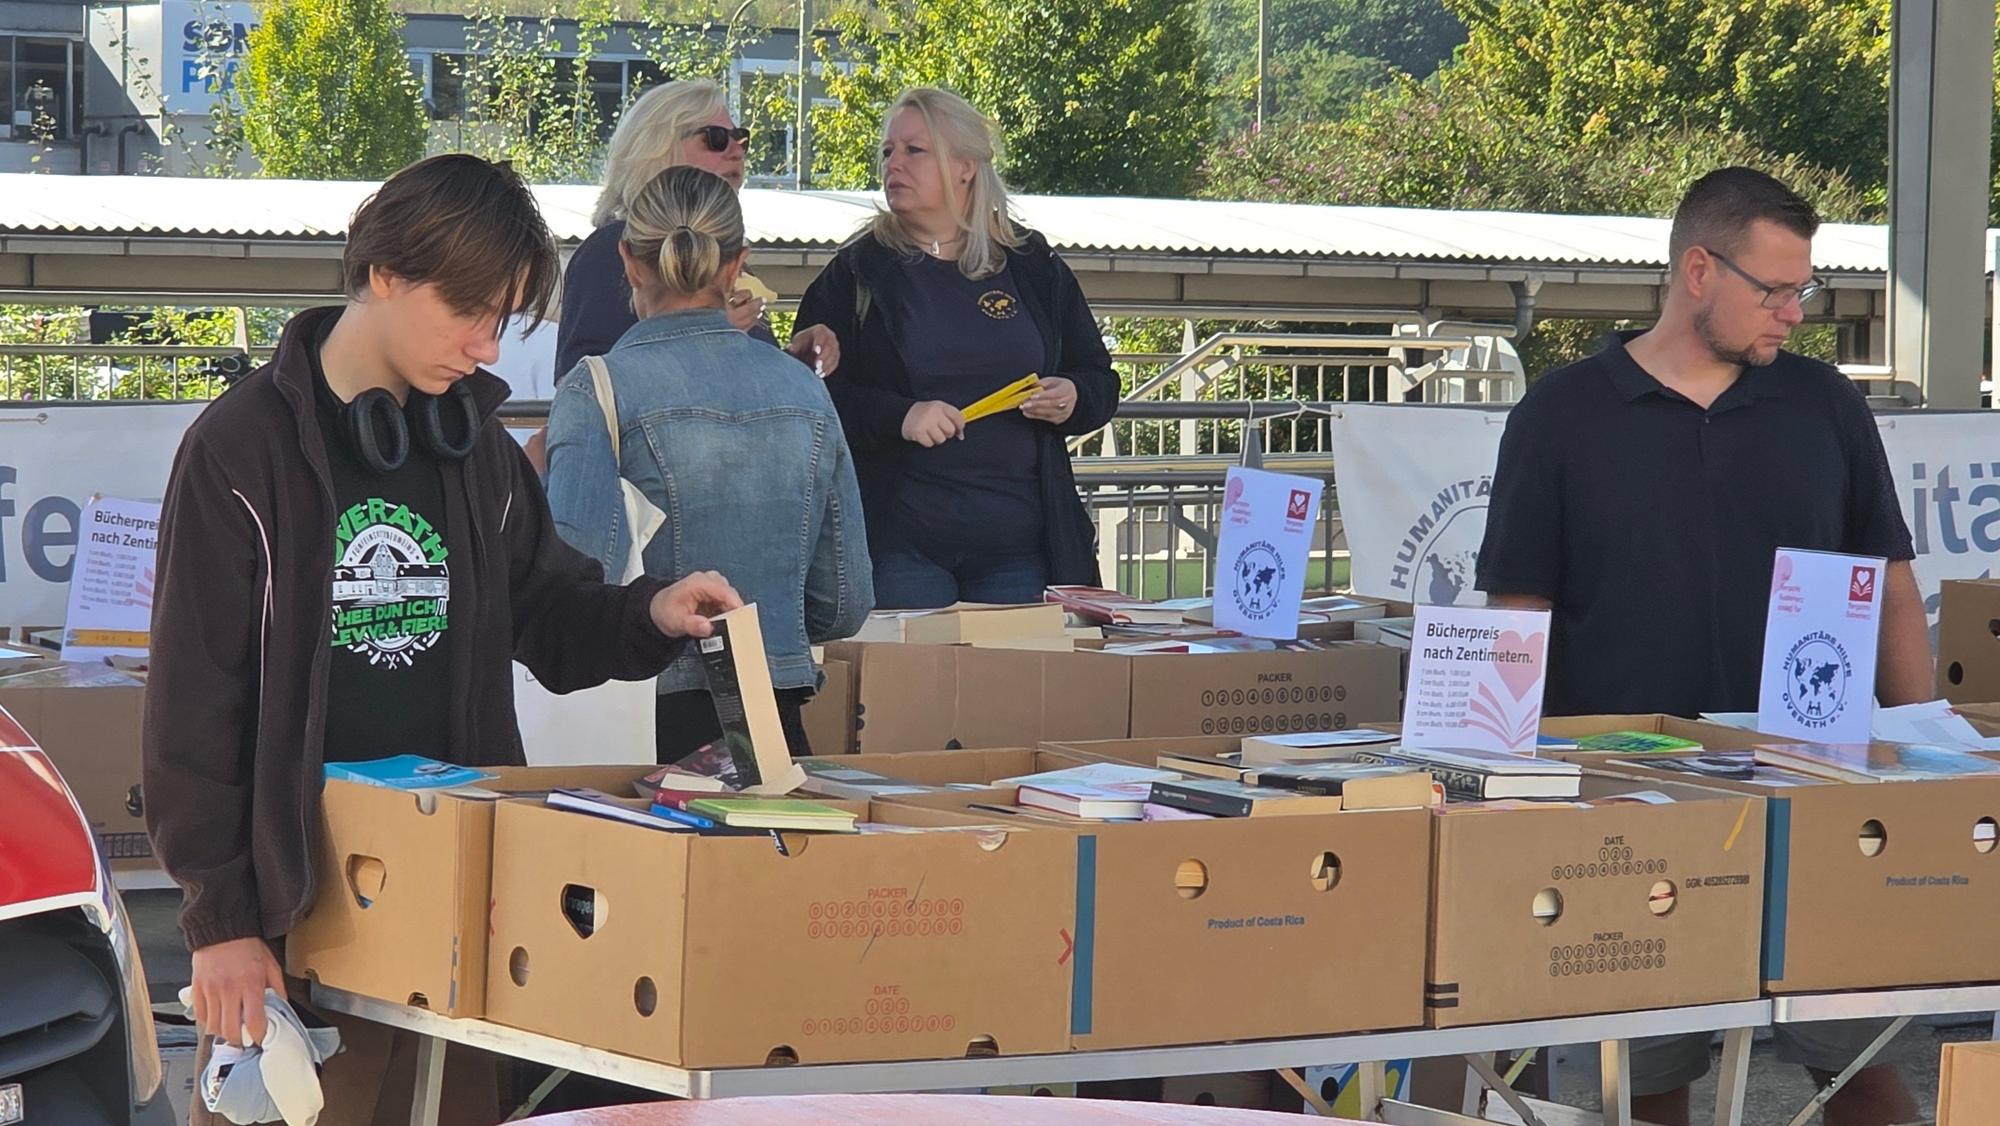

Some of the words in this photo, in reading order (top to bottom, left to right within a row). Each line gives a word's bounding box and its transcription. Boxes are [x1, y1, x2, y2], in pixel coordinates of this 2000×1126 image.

[91, 532, 120, 545] nach
[338, 608, 373, 627] HEE
[407, 600, 437, 616] ICH
[1427, 623, 1500, 642] Bücherpreis
[1424, 646, 1453, 660] nach
[1456, 647, 1533, 664] Zentimetern.
[1837, 643, 1852, 677] HILFE
[1258, 673, 1292, 683] PACKER
[1604, 836, 1625, 846] DATE
[868, 888, 907, 899] PACKER
[1208, 918, 1244, 929] Product
[1246, 917, 1256, 927] of
[1257, 917, 1283, 926] Costa
[1285, 915, 1305, 926] Rica
[874, 985, 901, 995] DATE
